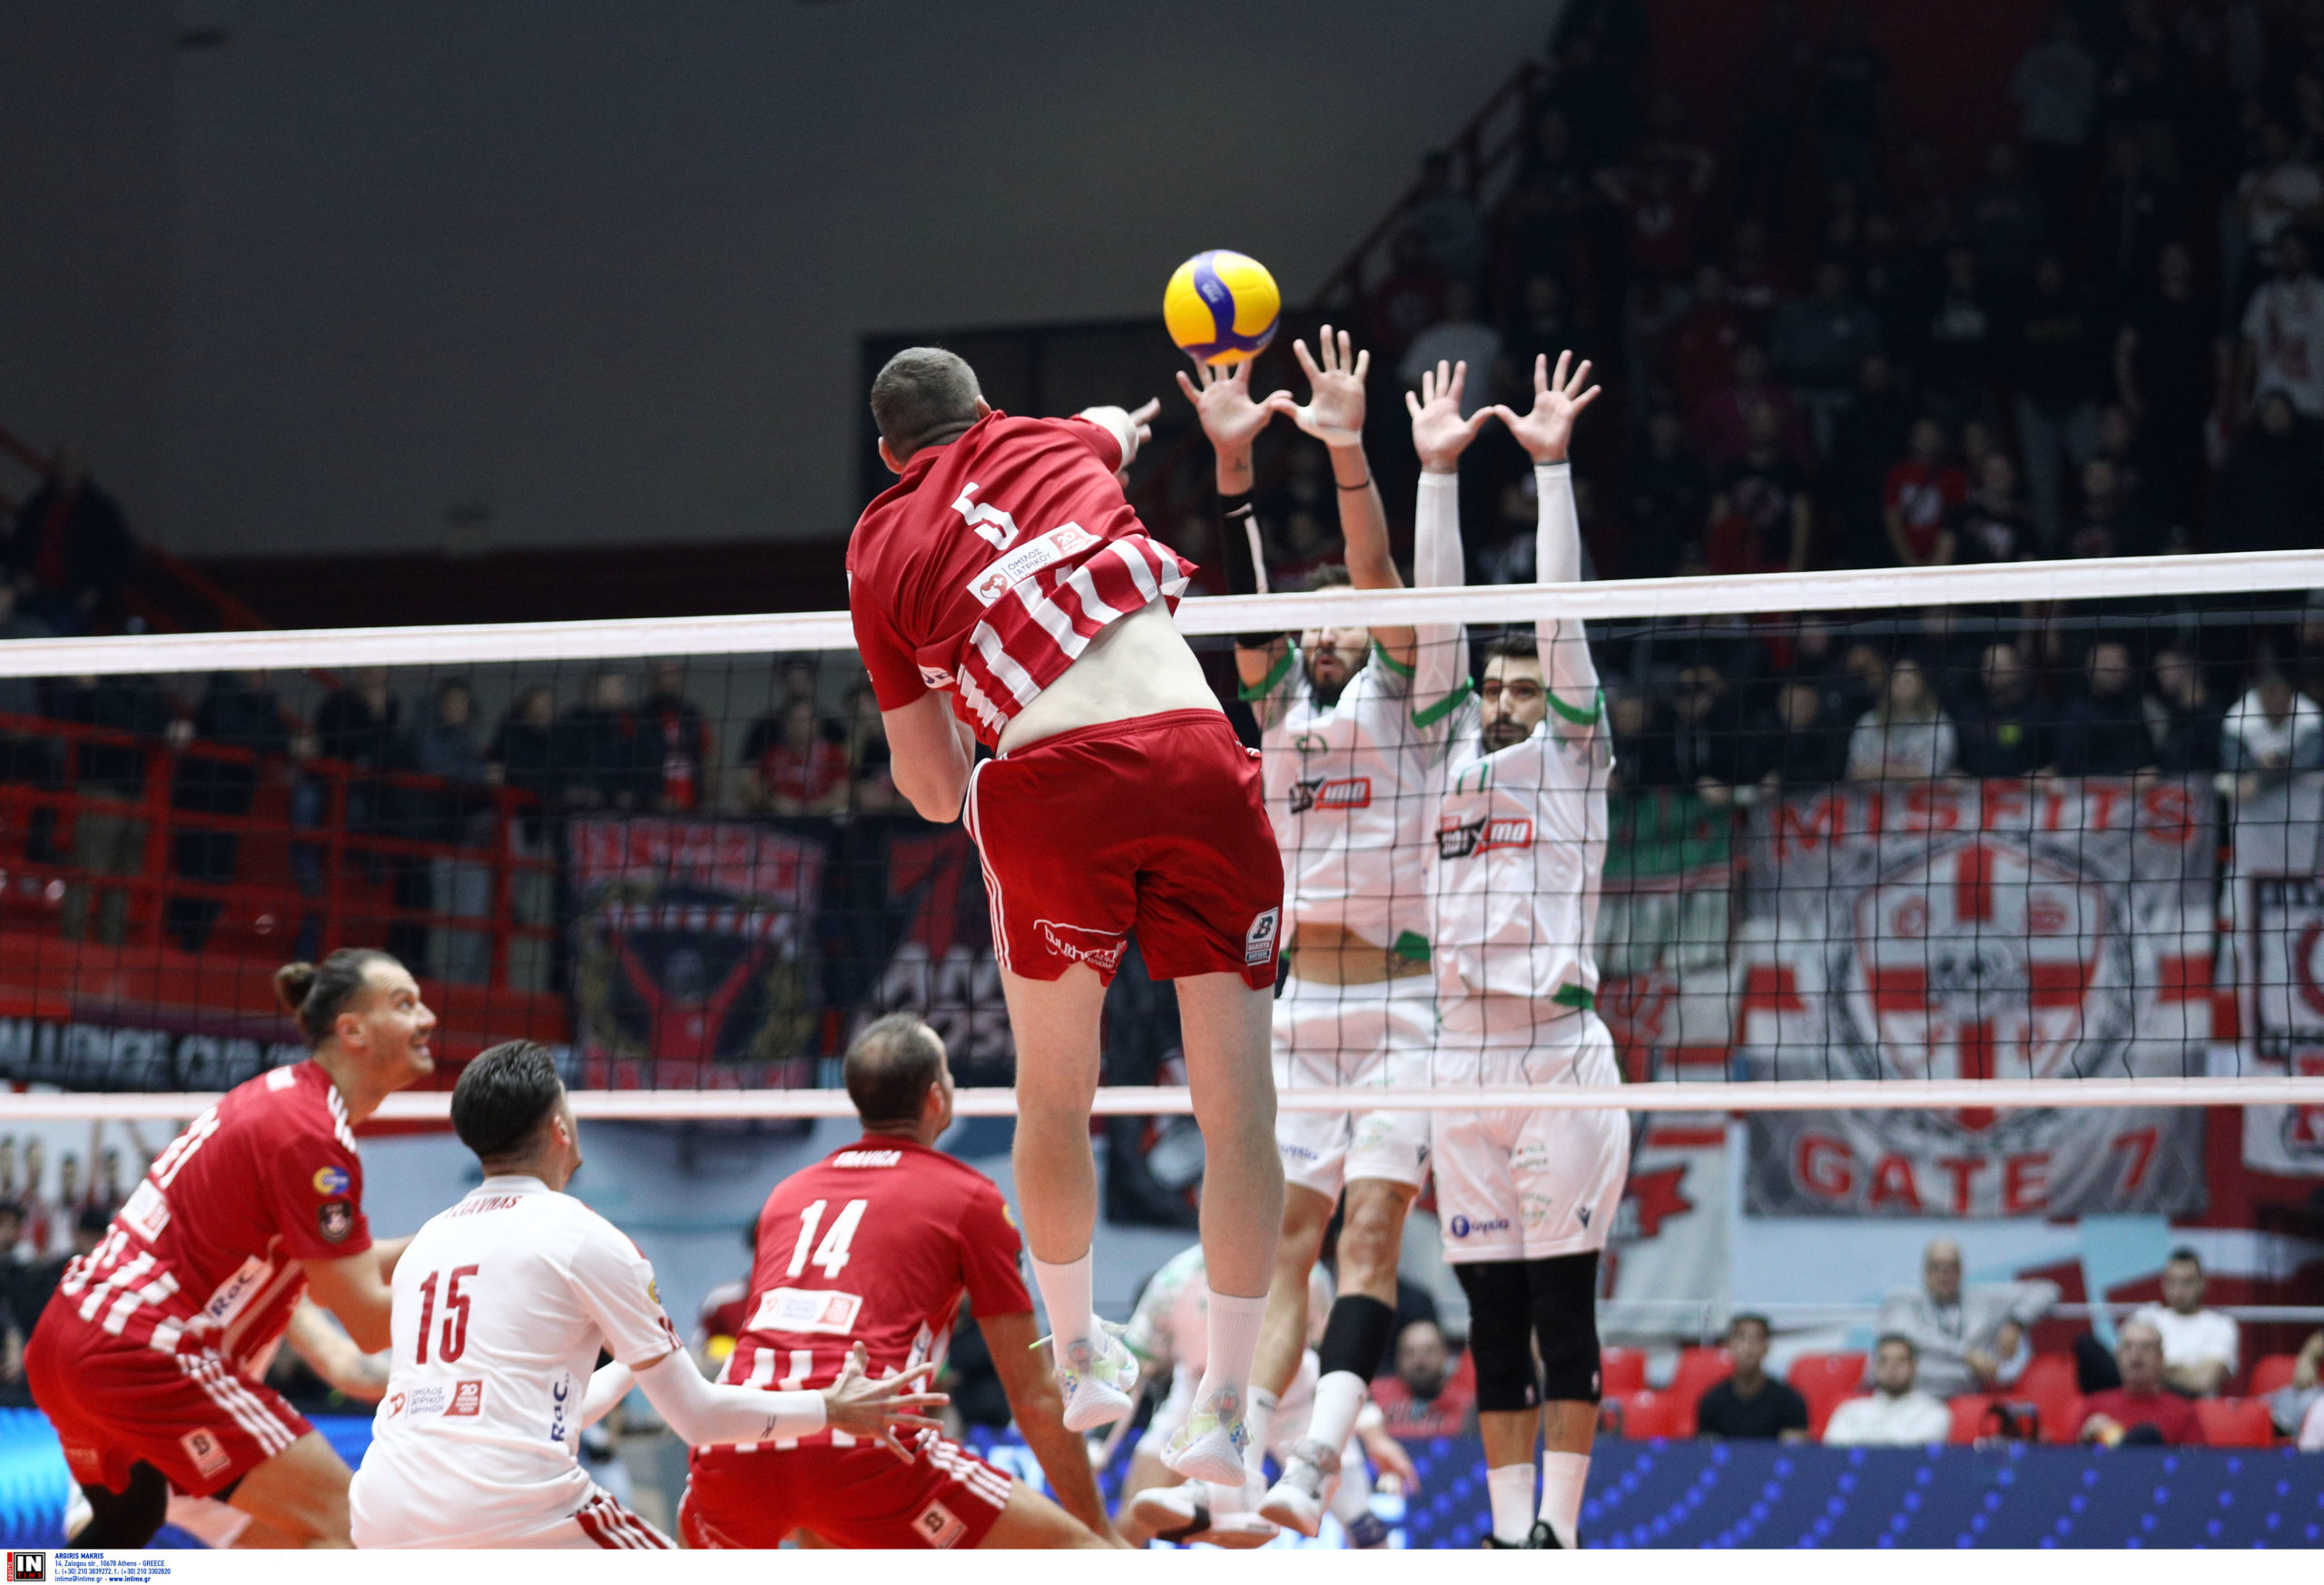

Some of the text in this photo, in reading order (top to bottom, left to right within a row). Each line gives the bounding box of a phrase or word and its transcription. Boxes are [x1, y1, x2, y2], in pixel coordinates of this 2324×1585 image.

[951, 482, 1019, 551] 5
[1769, 778, 2195, 860] MISFITS
[1794, 1126, 2160, 1215] GATE 7
[786, 1199, 869, 1279] 14
[416, 1264, 480, 1365] 15
[550, 1381, 568, 1442] RaC
